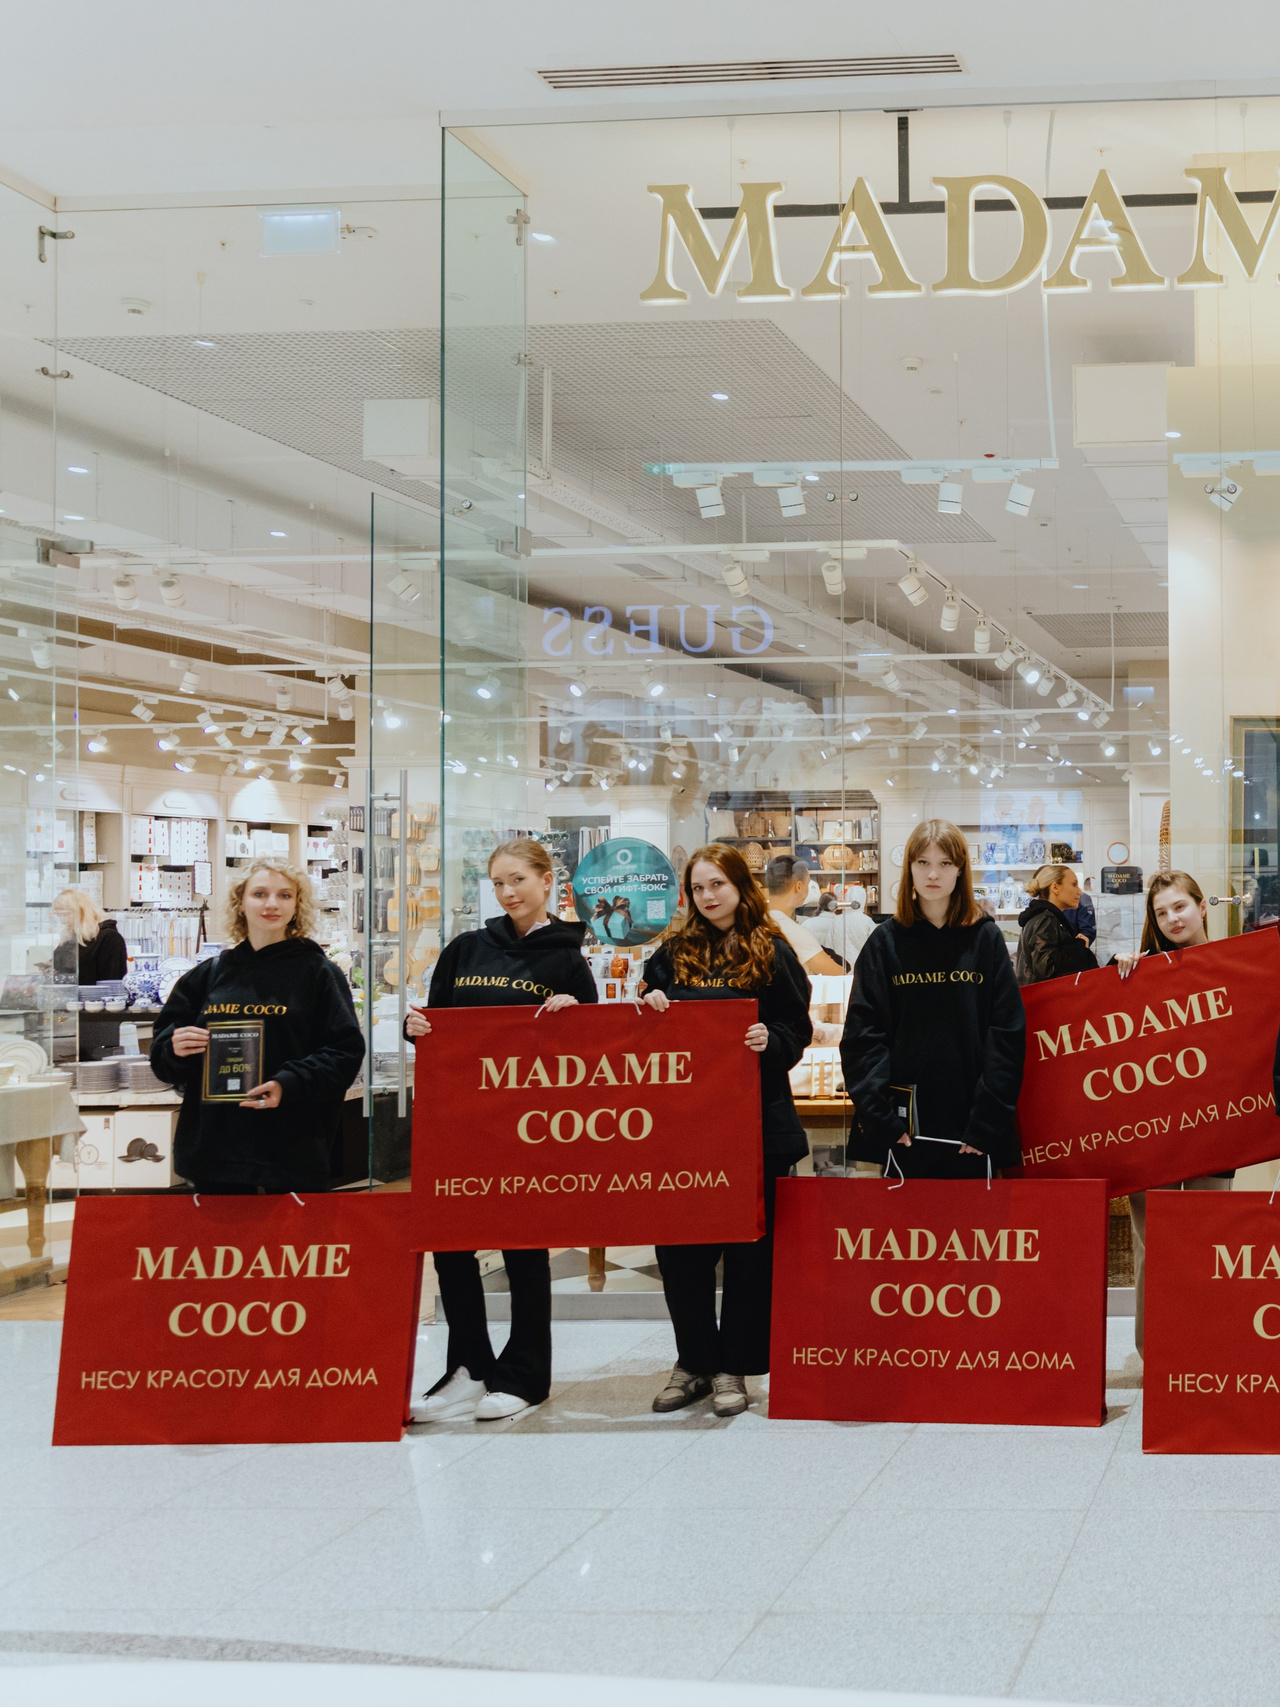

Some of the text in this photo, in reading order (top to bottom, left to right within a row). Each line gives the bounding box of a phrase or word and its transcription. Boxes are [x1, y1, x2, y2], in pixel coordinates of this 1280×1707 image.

[581, 873, 669, 885] УСПЕЙТЕ ЗАБРАТЬ
[584, 883, 667, 895] СВОЙ ГИФТ-БОКС
[454, 975, 554, 998] MADAME COCO
[243, 1004, 288, 1015] COCO
[1034, 987, 1233, 1061] MADAME
[478, 1051, 693, 1090] MADAME
[1082, 1046, 1208, 1101] COCO
[518, 1108, 653, 1144] COCO
[1021, 1091, 1276, 1166] НЕСУ КРАСОТУ ДЛЯ ДОМ
[435, 1171, 730, 1197] НЕСУ КРАСОТУ ДЛЯ ДОМА
[833, 1227, 1040, 1262] MADAME
[132, 1244, 351, 1281] MADAME
[870, 1283, 1001, 1318] COCO
[168, 1300, 307, 1337] COCO
[793, 1347, 1075, 1371] НЕСУ КРАСОТУ ДЛЯ ДОМА
[81, 1367, 379, 1390] НЕСУ КРАСОТУ ДЛЯ ДОМА
[1168, 1373, 1229, 1394] НЕСУ
